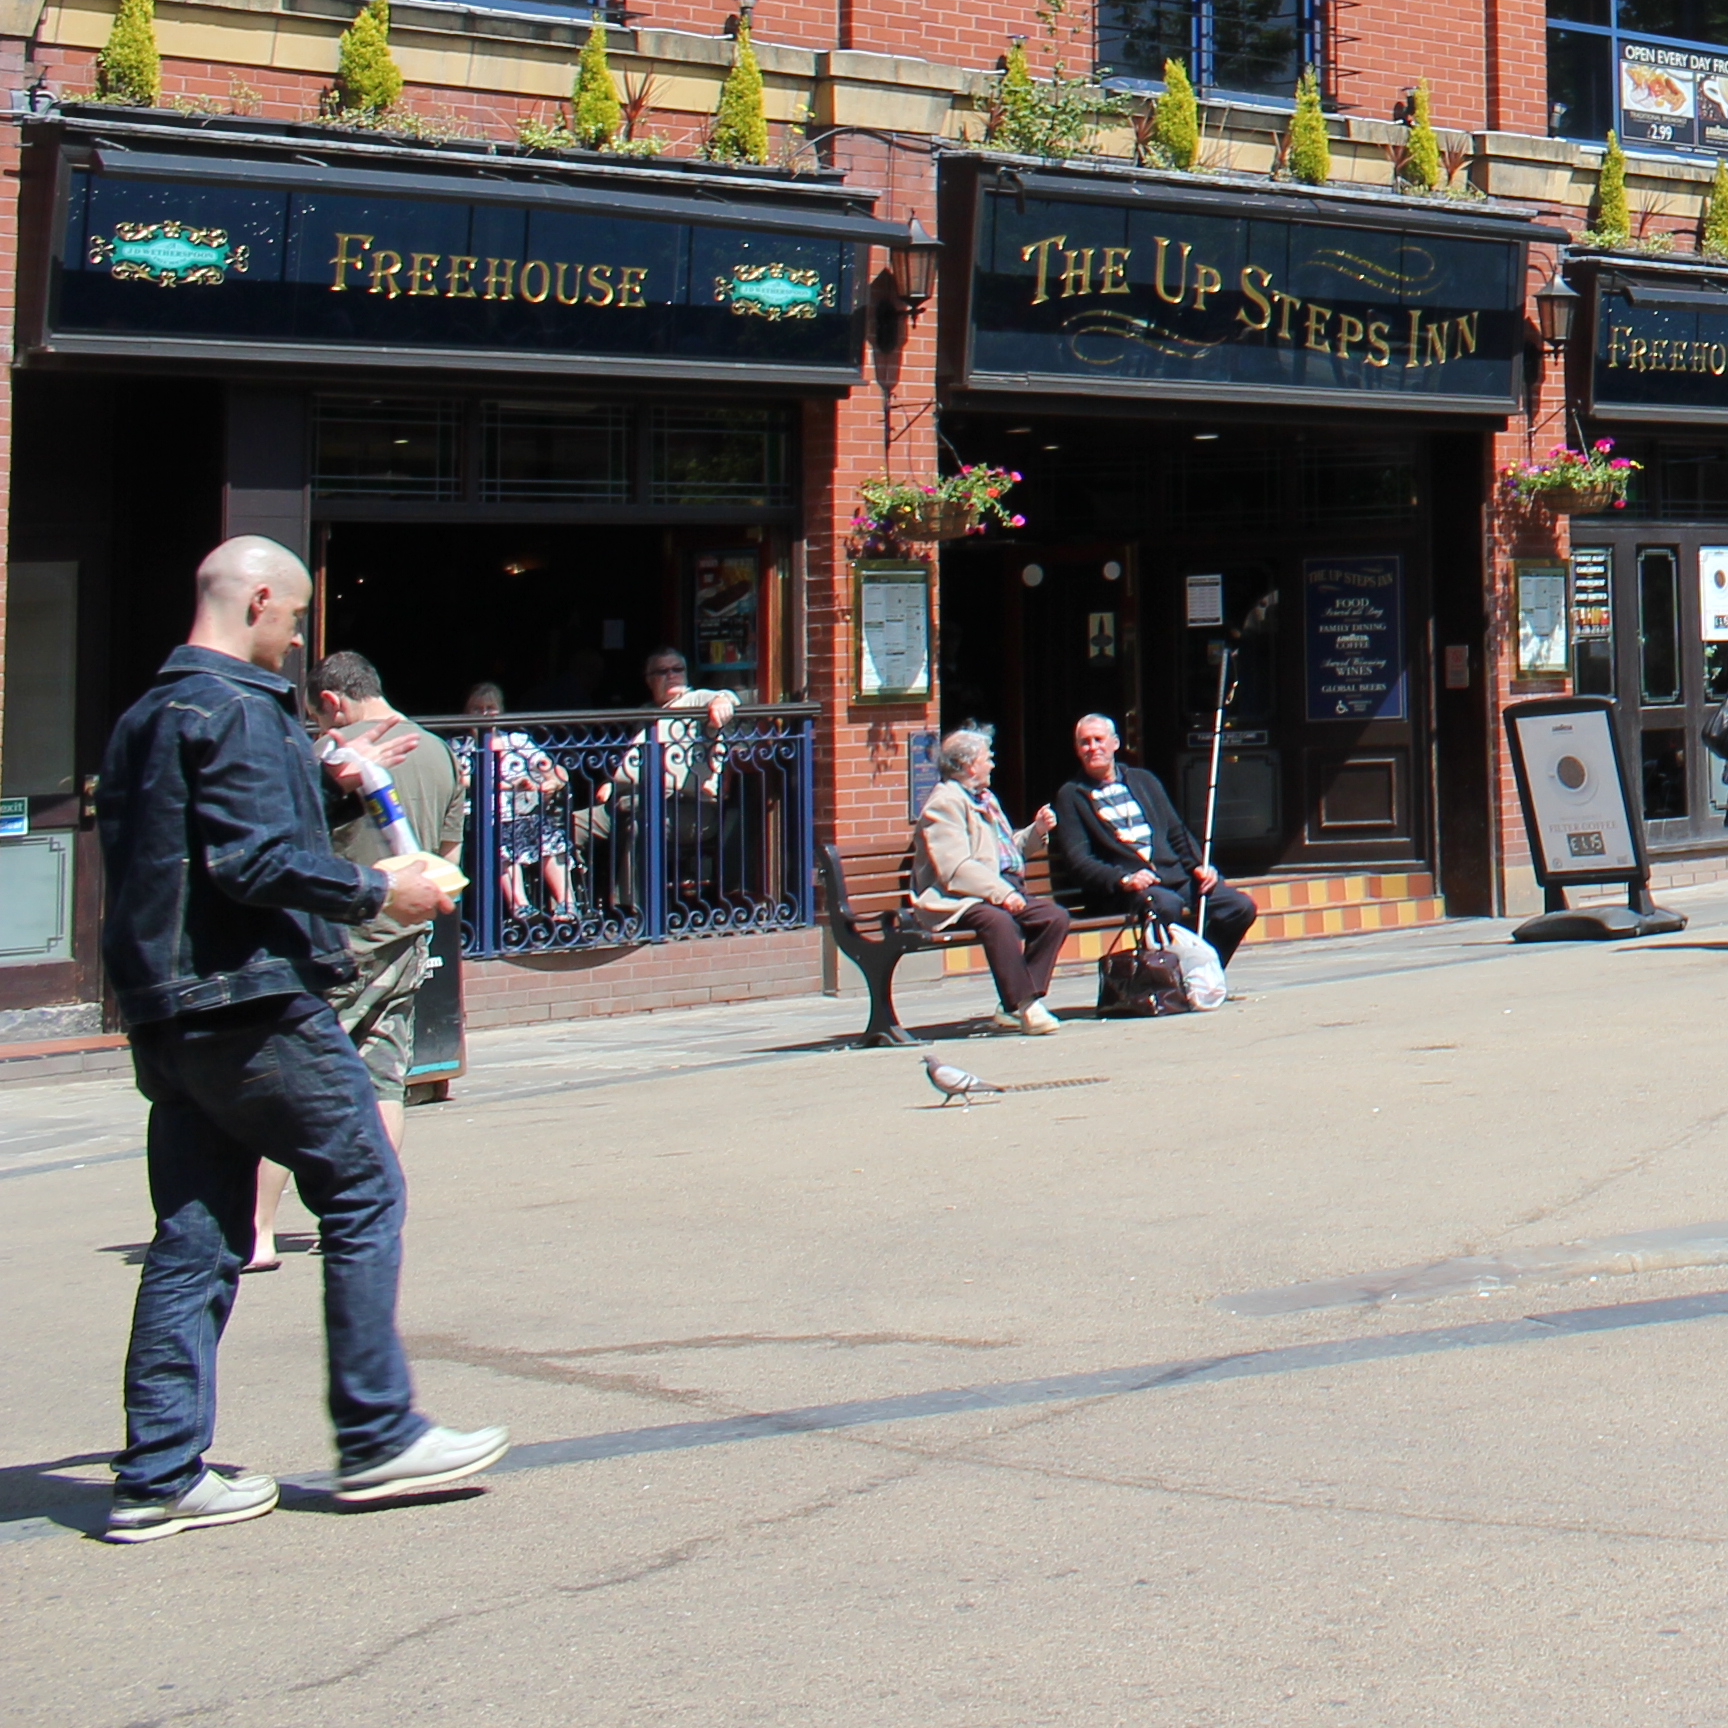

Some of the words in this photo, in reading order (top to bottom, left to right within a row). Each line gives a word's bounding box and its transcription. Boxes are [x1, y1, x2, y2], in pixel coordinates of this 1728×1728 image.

[1625, 44, 1655, 63] OPEN
[1657, 50, 1688, 68] EVERY
[1690, 55, 1712, 72] DAY
[142, 248, 214, 259] WETHERSPOON
[1344, 571, 1377, 588] STEPS
[1335, 597, 1370, 609] FOOD
[1319, 623, 1349, 633] FAMILY
[1352, 622, 1387, 632] DINING
[1335, 640, 1371, 650] COFFEE
[1336, 665, 1372, 676] WINES
[1321, 683, 1355, 693] GLOBAL
[1358, 682, 1387, 692] BEERS
[2, 801, 23, 812] exit
[1548, 824, 1578, 833] FILTER
[1581, 821, 1616, 831] COFFEE
